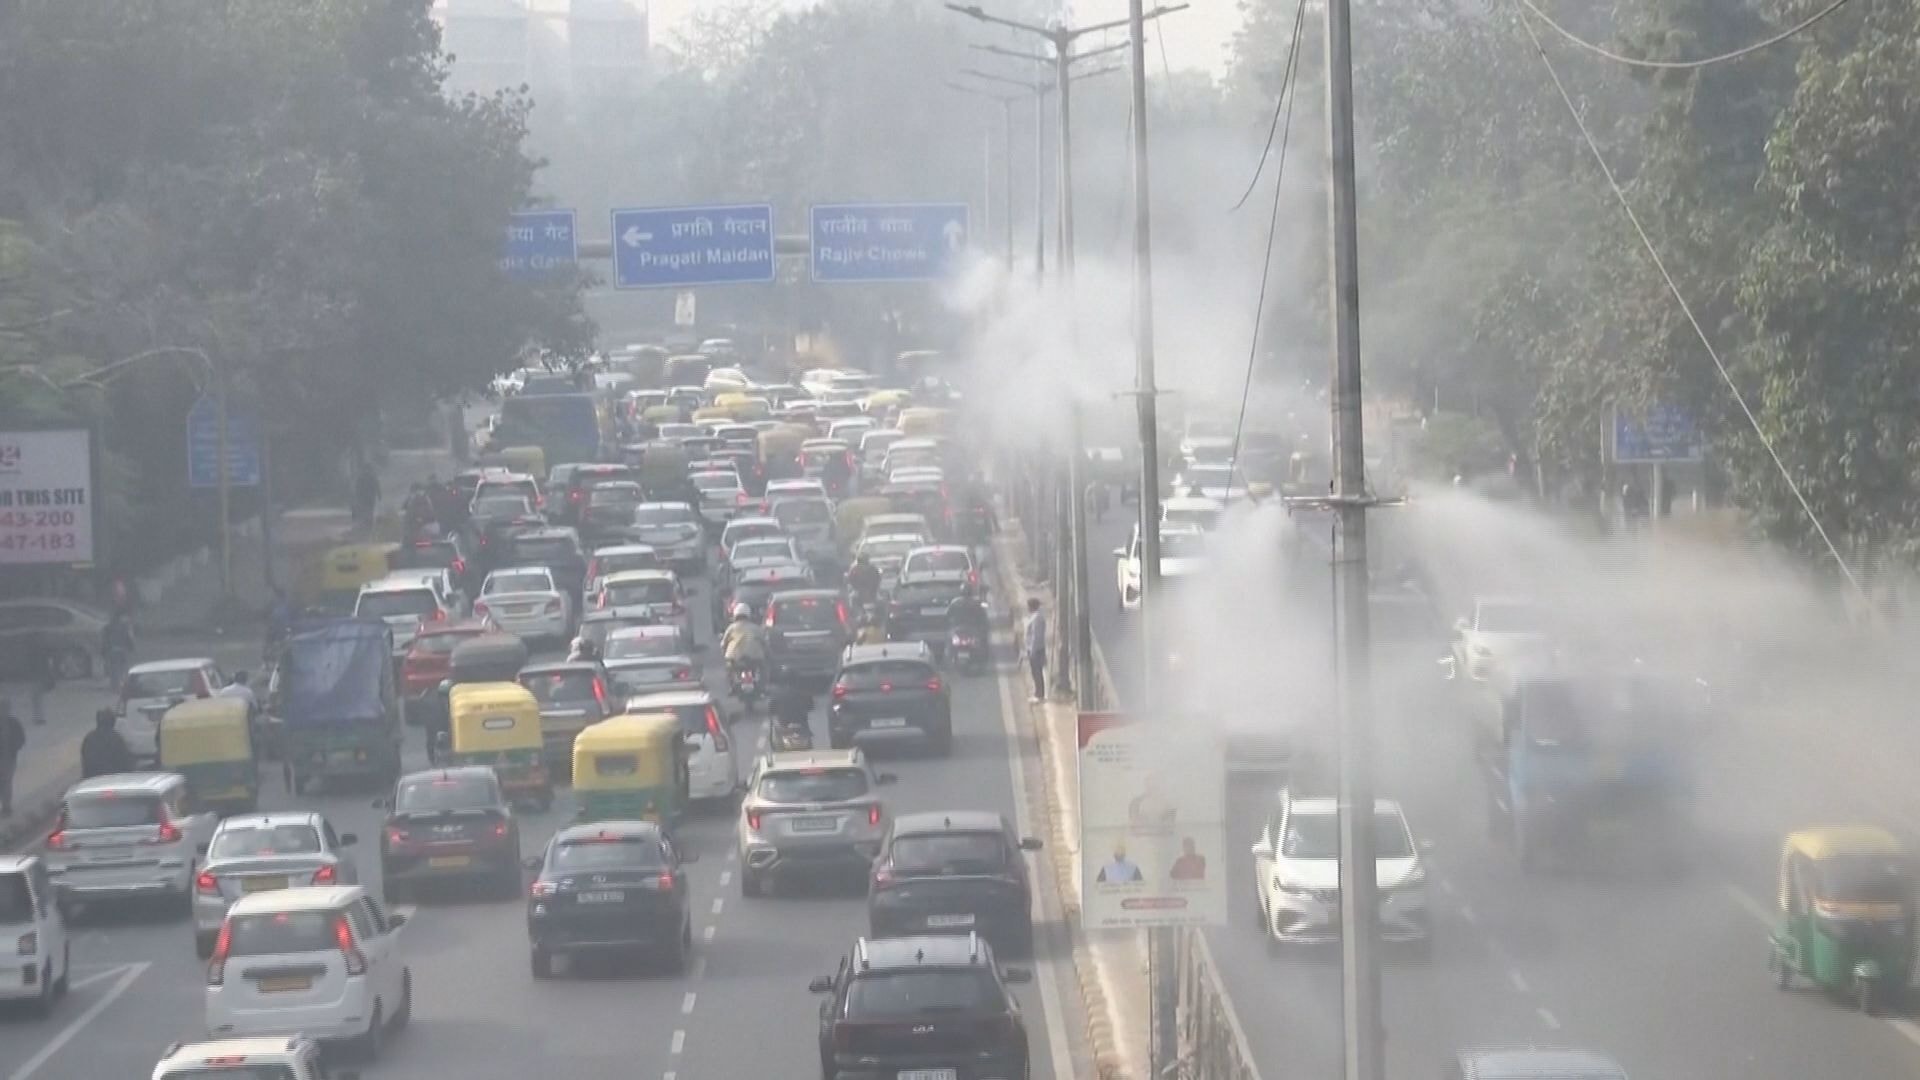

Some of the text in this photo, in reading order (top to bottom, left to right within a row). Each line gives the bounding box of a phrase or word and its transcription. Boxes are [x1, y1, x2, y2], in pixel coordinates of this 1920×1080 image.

[640, 247, 769, 270] Pragati Maidan
[820, 247, 863, 265] Rajiv
[16, 489, 49, 506] THIS
[53, 488, 84, 505] SITE
